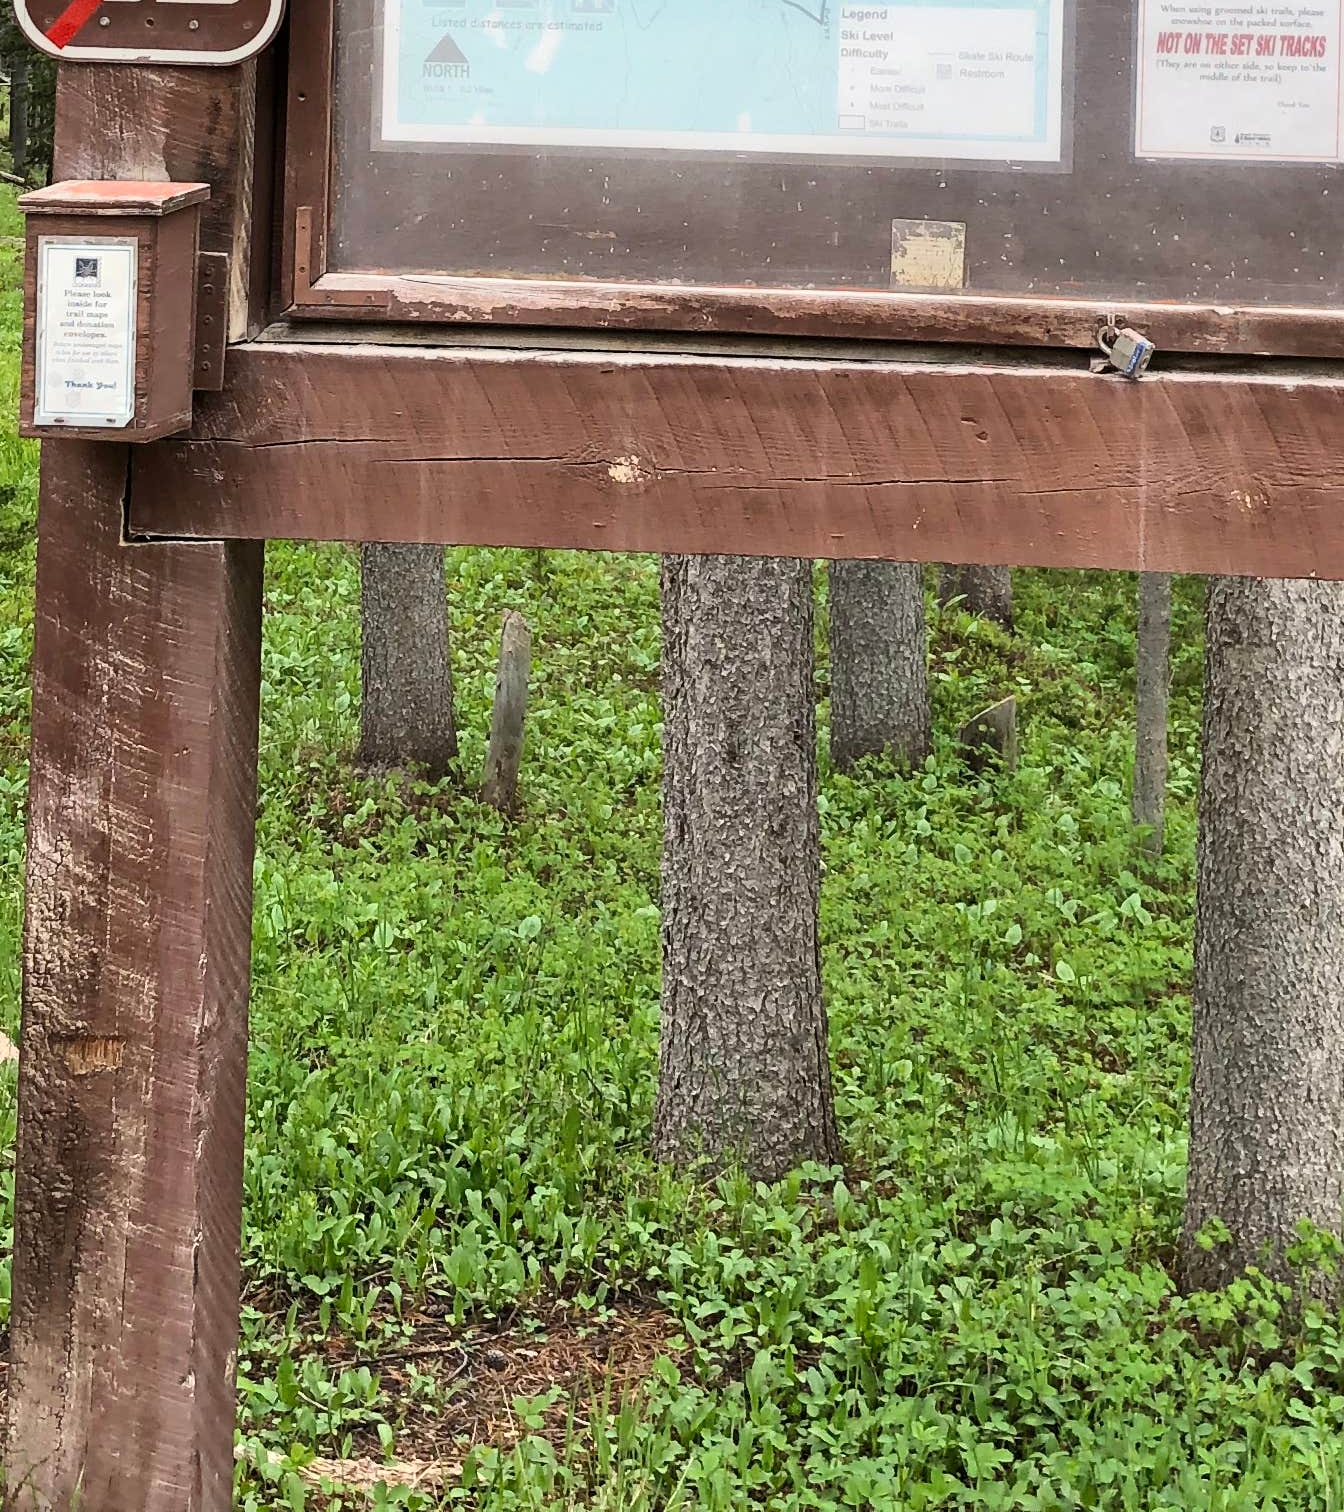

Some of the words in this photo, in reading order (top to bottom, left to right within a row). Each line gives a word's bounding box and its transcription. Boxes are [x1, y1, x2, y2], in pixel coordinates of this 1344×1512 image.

[841, 7, 889, 22] Legend
[1160, 5, 1186, 14] When
[1189, 6, 1212, 16] using
[1214, 5, 1254, 16] groomed
[1256, 6, 1268, 16] ski
[1271, 7, 1295, 17] trails,
[1297, 8, 1325, 18] please
[432, 15, 467, 29] Listed
[471, 17, 522, 30] distances
[547, 19, 603, 32] estimated
[1229, 18, 1244, 27] the
[1246, 18, 1277, 29] packed
[841, 30, 860, 40] Ski
[863, 30, 894, 41] Level
[1156, 31, 1183, 54] NOT
[1183, 32, 1203, 55] ON
[1205, 32, 1229, 55] THE
[1230, 33, 1254, 56] SET
[1256, 34, 1277, 57] SKI
[1279, 34, 1327, 58] TRACKS
[840, 48, 889, 62] Difficulty
[422, 63, 470, 79] NORTH
[1183, 61, 1198, 69] are
[1277, 61, 1298, 73] keep
[1312, 63, 1327, 72] the
[1199, 73, 1229, 82] middle
[1231, 73, 1242, 82] of
[1243, 73, 1257, 82] the
[64, 290, 91, 298] Please
[93, 290, 111, 298] look
[66, 310, 84, 318] trail
[64, 380, 93, 389] Thank
[95, 381, 117, 390] You!
